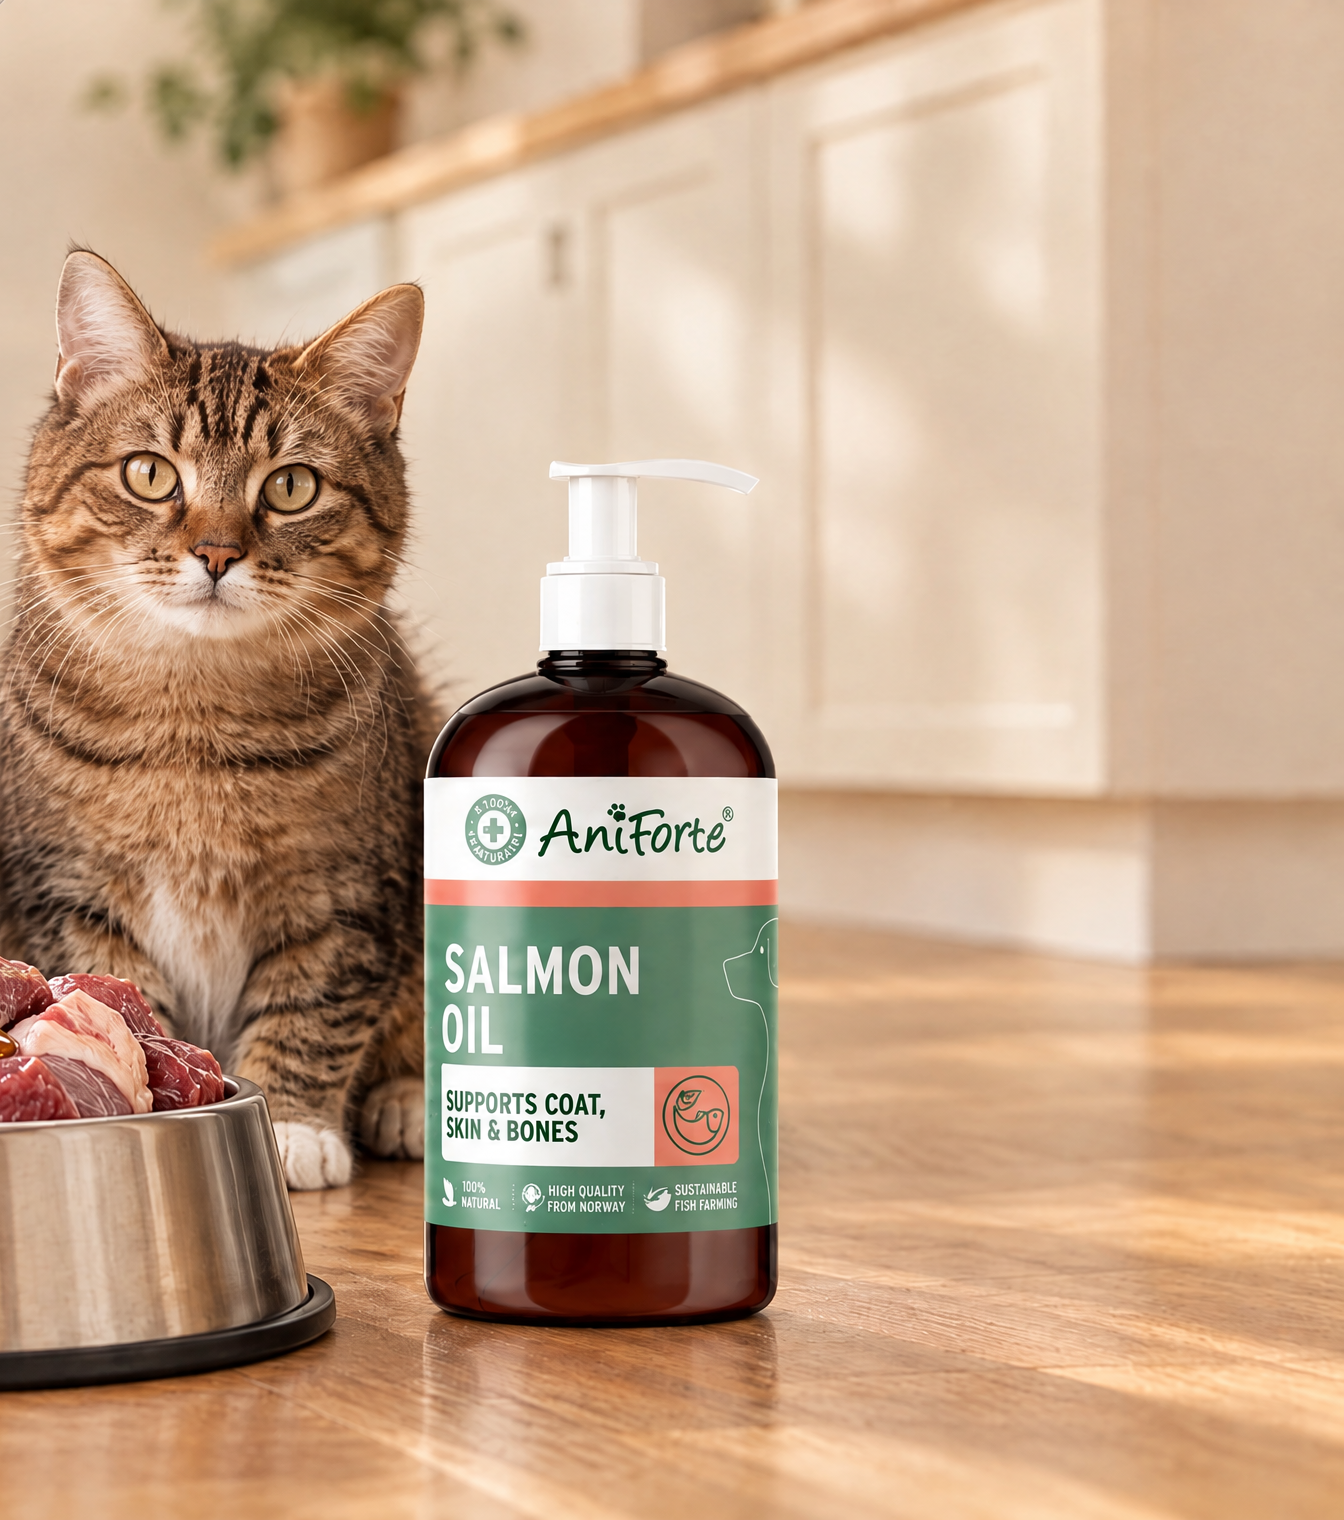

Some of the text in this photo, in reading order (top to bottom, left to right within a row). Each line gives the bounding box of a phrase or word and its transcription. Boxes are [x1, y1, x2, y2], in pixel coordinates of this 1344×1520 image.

[444, 943, 639, 996] SALMON
[442, 1004, 503, 1054] OIL
[446, 1090, 606, 1119] SUPPORTS COAT,
[446, 1117, 578, 1143] SKIN & BONES
[462, 1181, 486, 1193] 100%
[548, 1185, 625, 1198] HIGH QUALITY
[674, 1182, 738, 1196] SUSTAINABLE
[461, 1196, 501, 1210] NATURAL
[547, 1200, 625, 1213] FROM NORWAY
[674, 1197, 738, 1211] FISH FARMING
